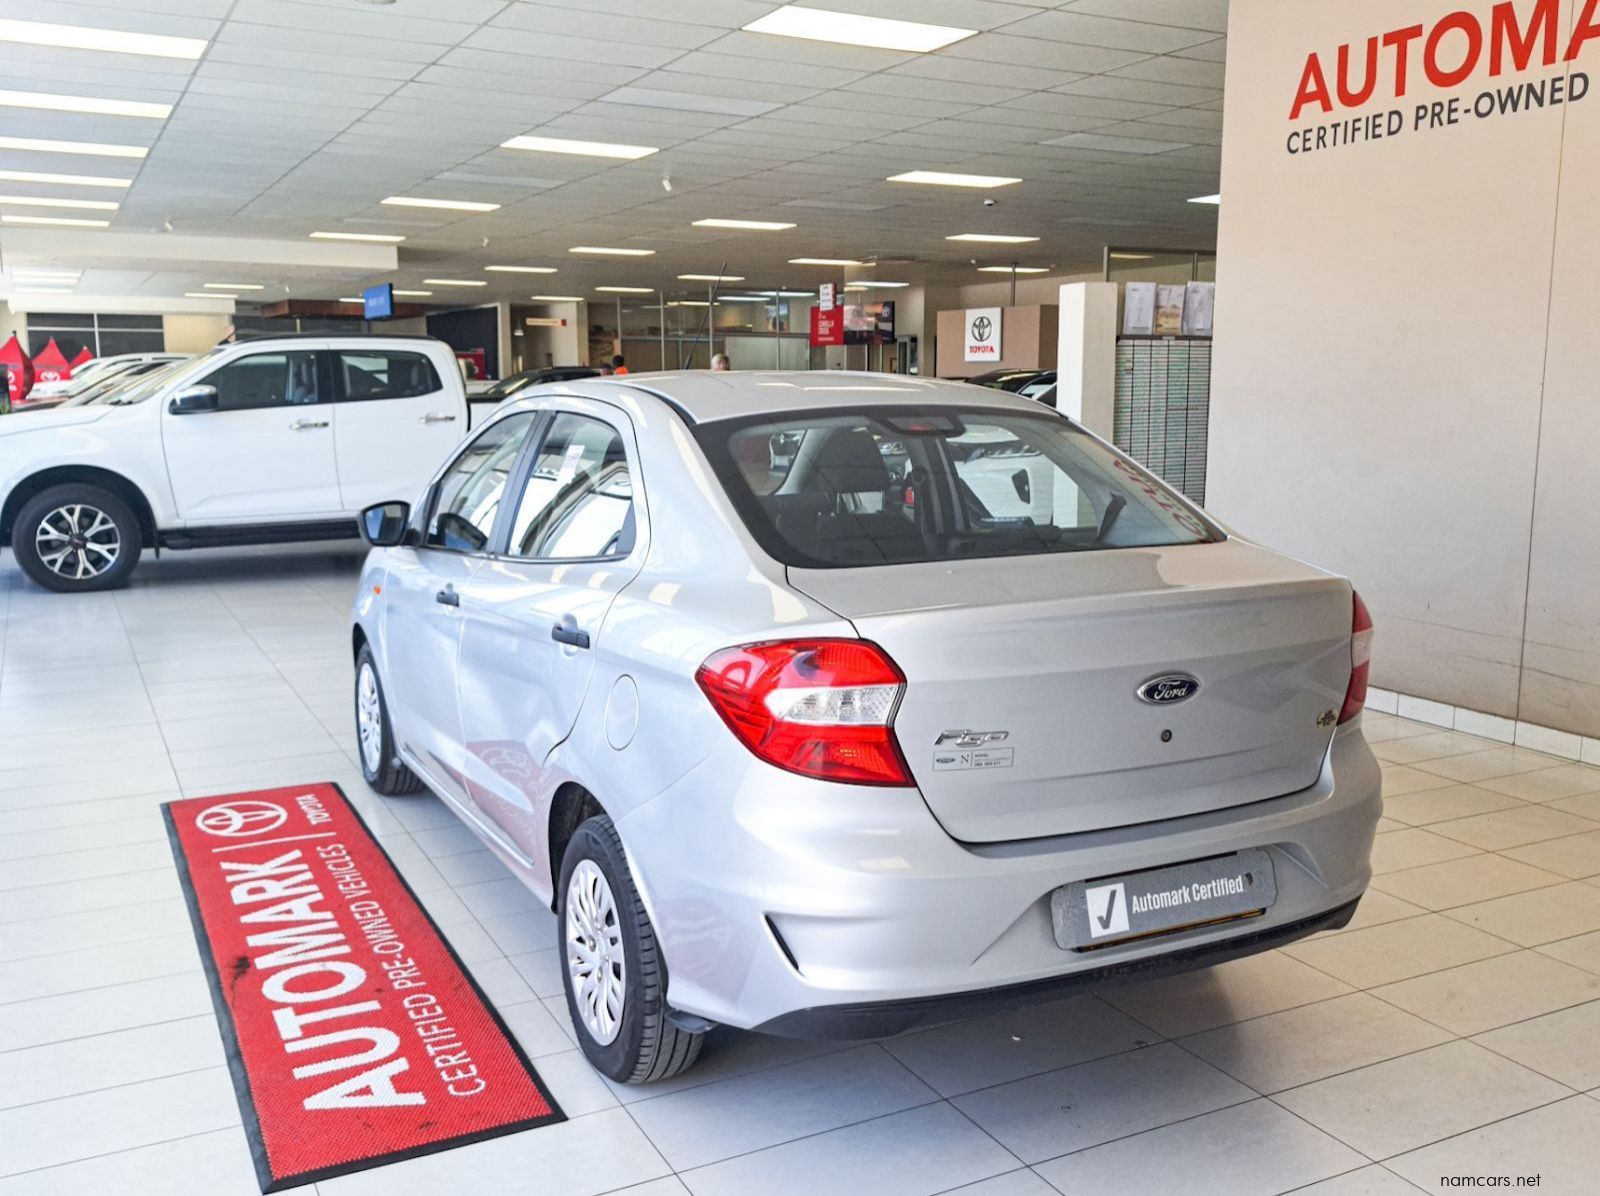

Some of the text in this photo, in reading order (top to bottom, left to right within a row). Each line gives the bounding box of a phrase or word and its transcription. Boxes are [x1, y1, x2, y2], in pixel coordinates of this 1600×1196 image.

[1286, 72, 1590, 154] CERTIFIED PRE-OWNED
[969, 345, 995, 353] TOYOTA
[1153, 680, 1189, 700] Ford
[934, 729, 1010, 748] Figo
[296, 793, 333, 826] TOYOTA
[1132, 874, 1244, 914] Automark Certified
[218, 848, 428, 1111] AUTOMARK
[315, 842, 487, 1097] CERTIFIED PRE-OWNED VEHICLES
